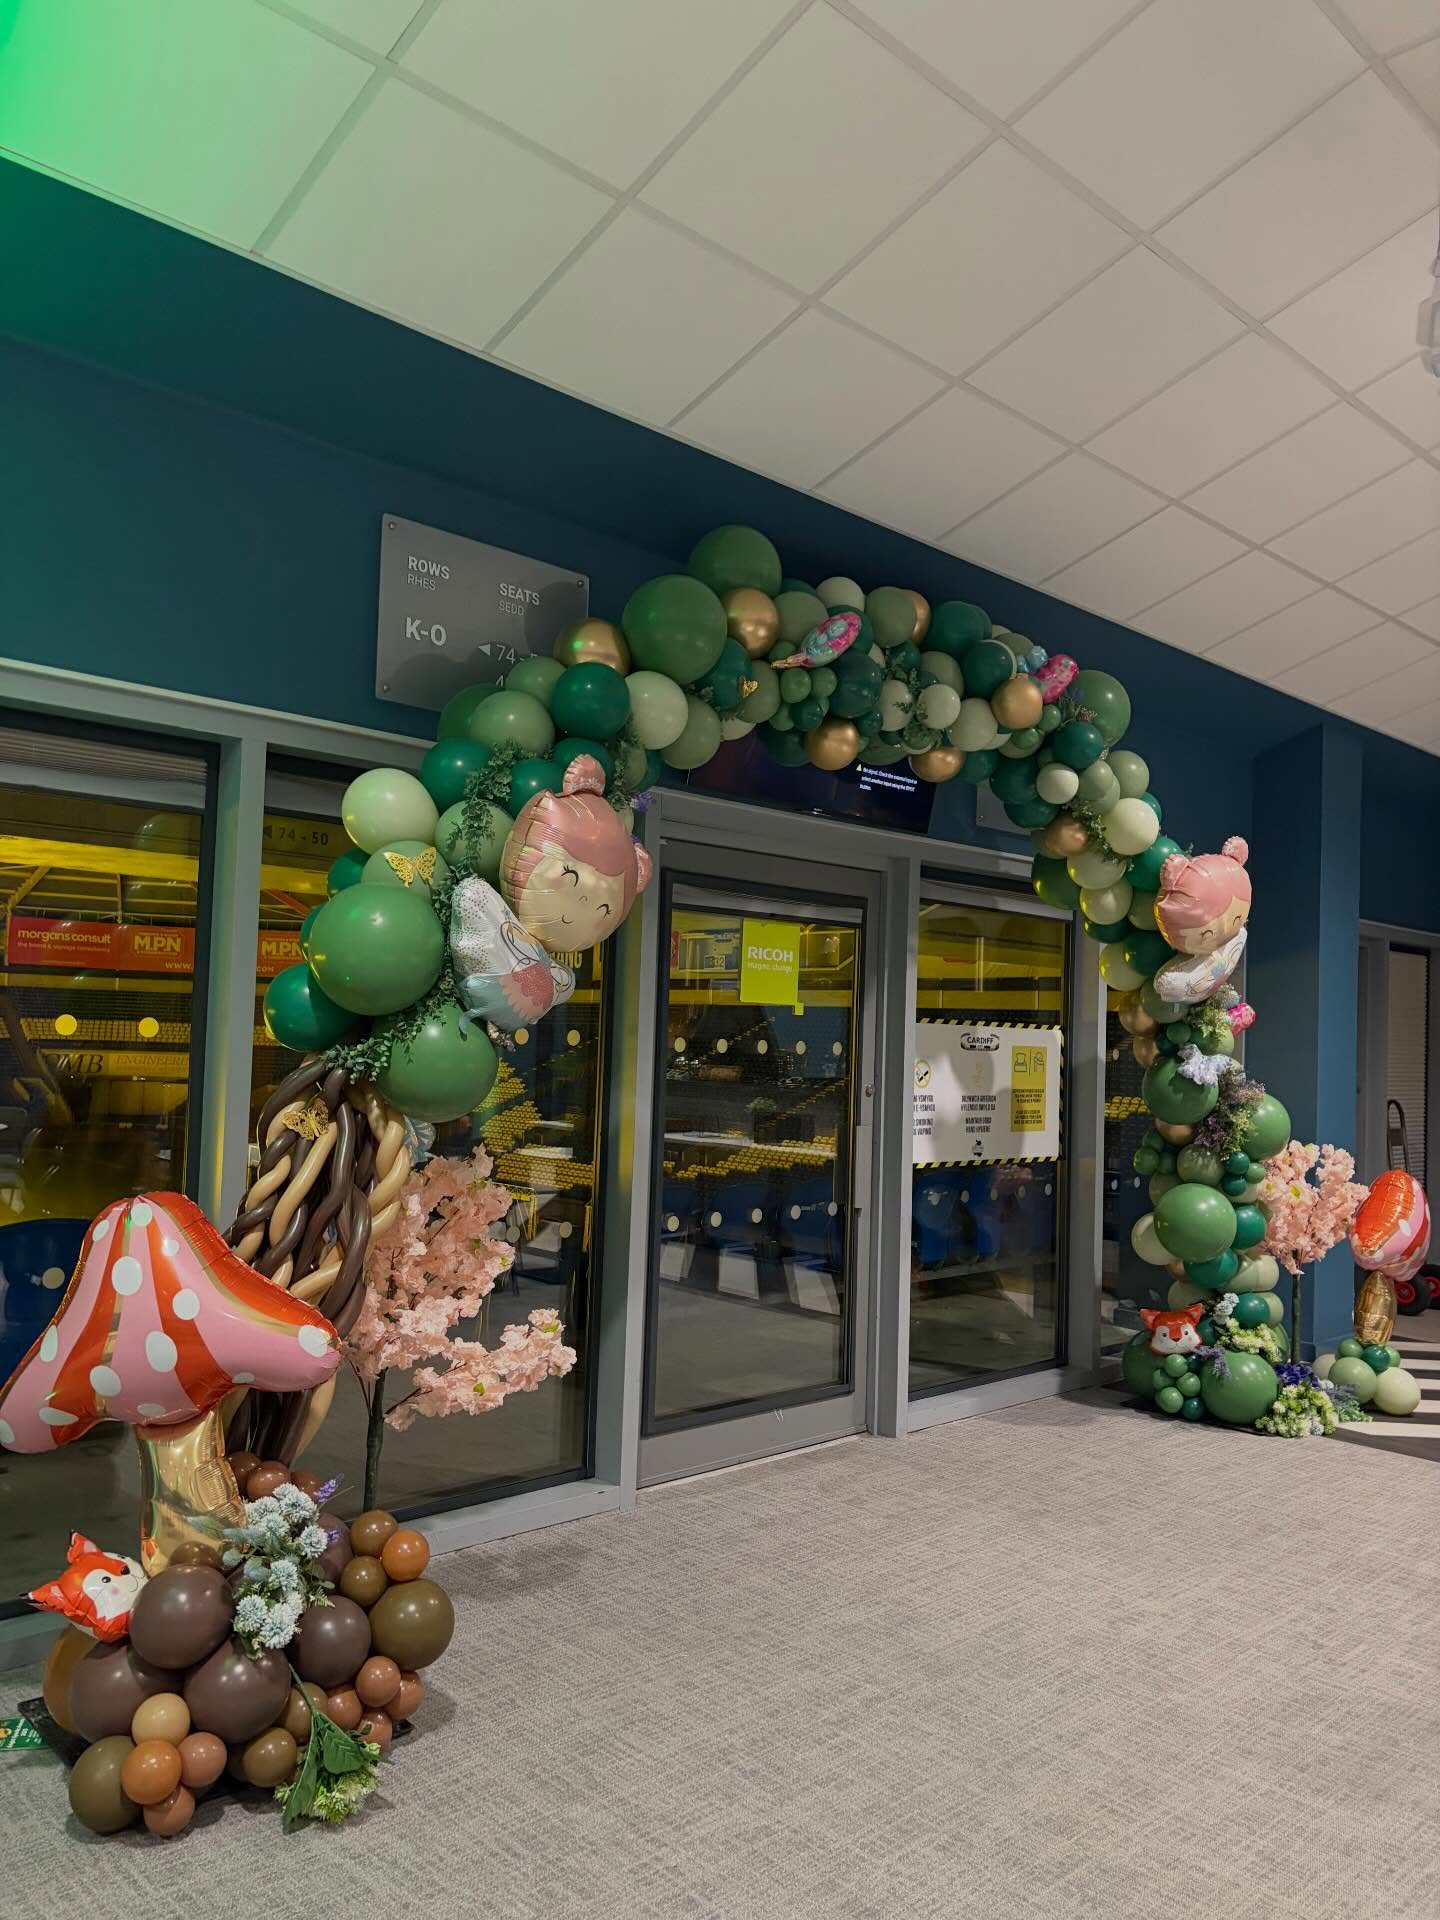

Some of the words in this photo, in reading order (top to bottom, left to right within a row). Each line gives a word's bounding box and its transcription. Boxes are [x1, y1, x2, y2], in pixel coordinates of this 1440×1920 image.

[407, 555, 450, 580] ROWS
[407, 573, 436, 591] RHES
[499, 582, 541, 606] SEATS
[498, 600, 525, 616] SEDD
[405, 616, 447, 647] K-O
[496, 644, 516, 664] 74
[312, 831, 329, 846] 50
[747, 946, 793, 963] RICOH
[966, 1036, 994, 1045] CARDIFF
